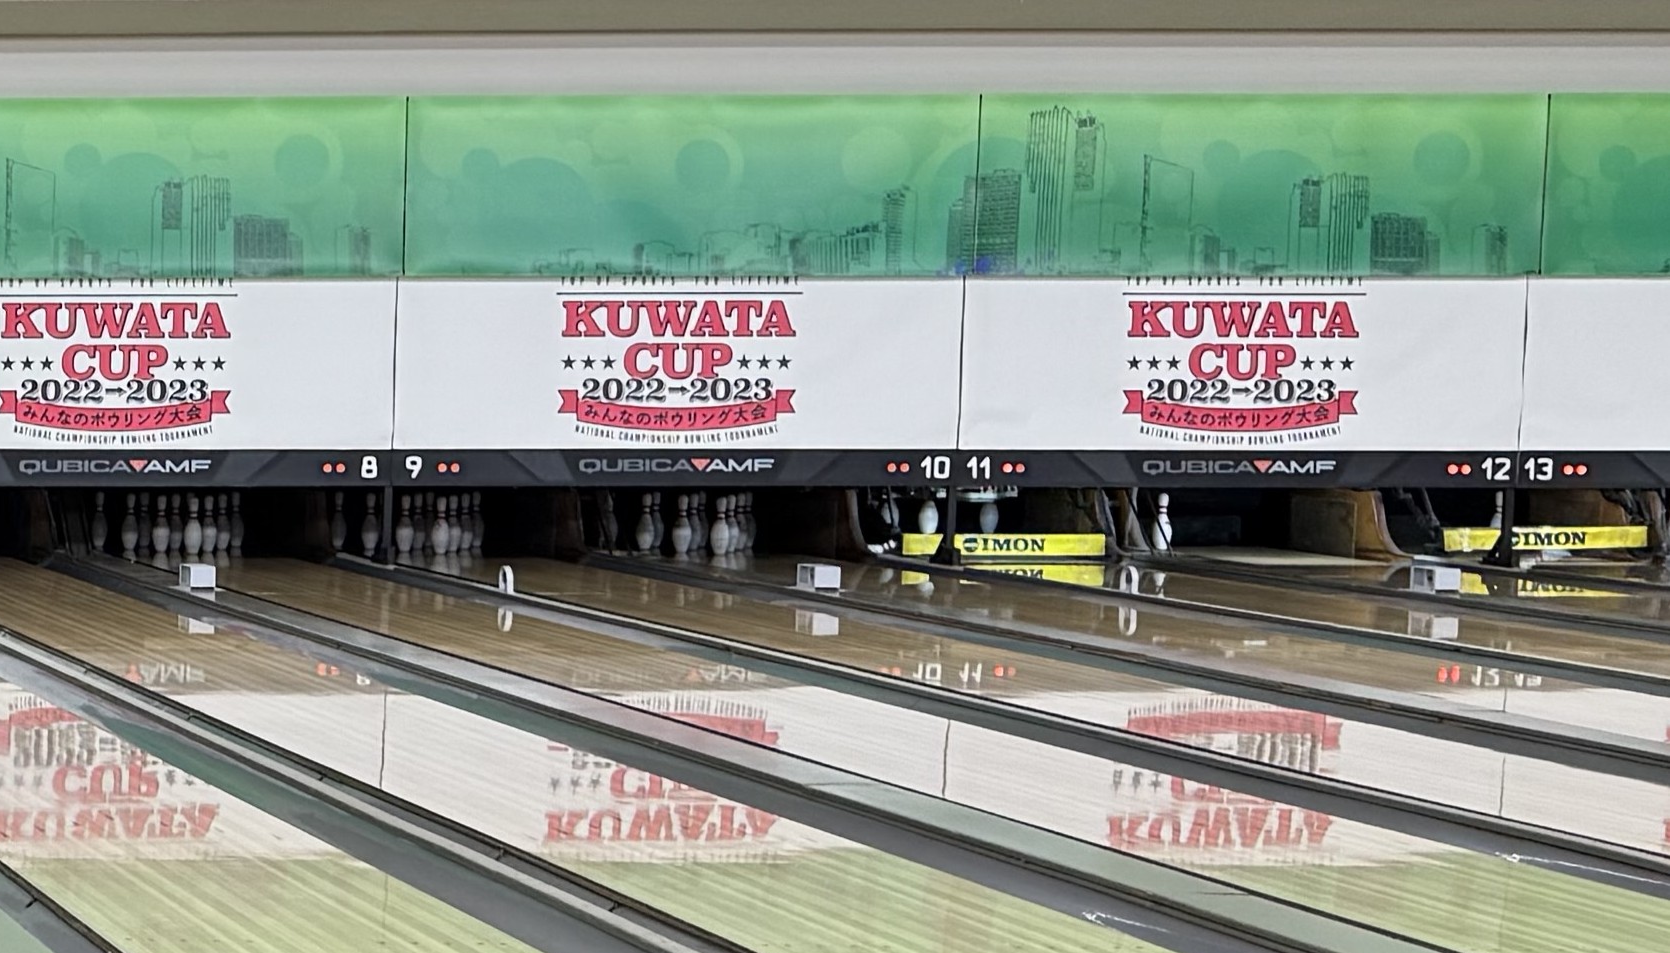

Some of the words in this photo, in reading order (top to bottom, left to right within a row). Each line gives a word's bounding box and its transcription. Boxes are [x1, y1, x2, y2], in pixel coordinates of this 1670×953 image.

[1, 302, 231, 339] KUWATA
[561, 300, 797, 337] KUWATA
[1128, 301, 1359, 338] KUWATA
[61, 344, 169, 381] CUP
[623, 342, 733, 380] CUP
[1188, 343, 1297, 380] CUP
[23, 406, 202, 428] みんなのボウリング大会
[584, 404, 767, 427] みんなのボウリング大会
[1149, 406, 1330, 428] みんなのボウリング大会
[360, 456, 377, 479] 8
[405, 456, 421, 479] 9
[920, 456, 950, 479] 10
[967, 456, 991, 479] 11
[1481, 457, 1510, 480] 12
[1524, 457, 1554, 481] 13
[979, 536, 1045, 553] IMON
[1522, 530, 1587, 547] IMON
